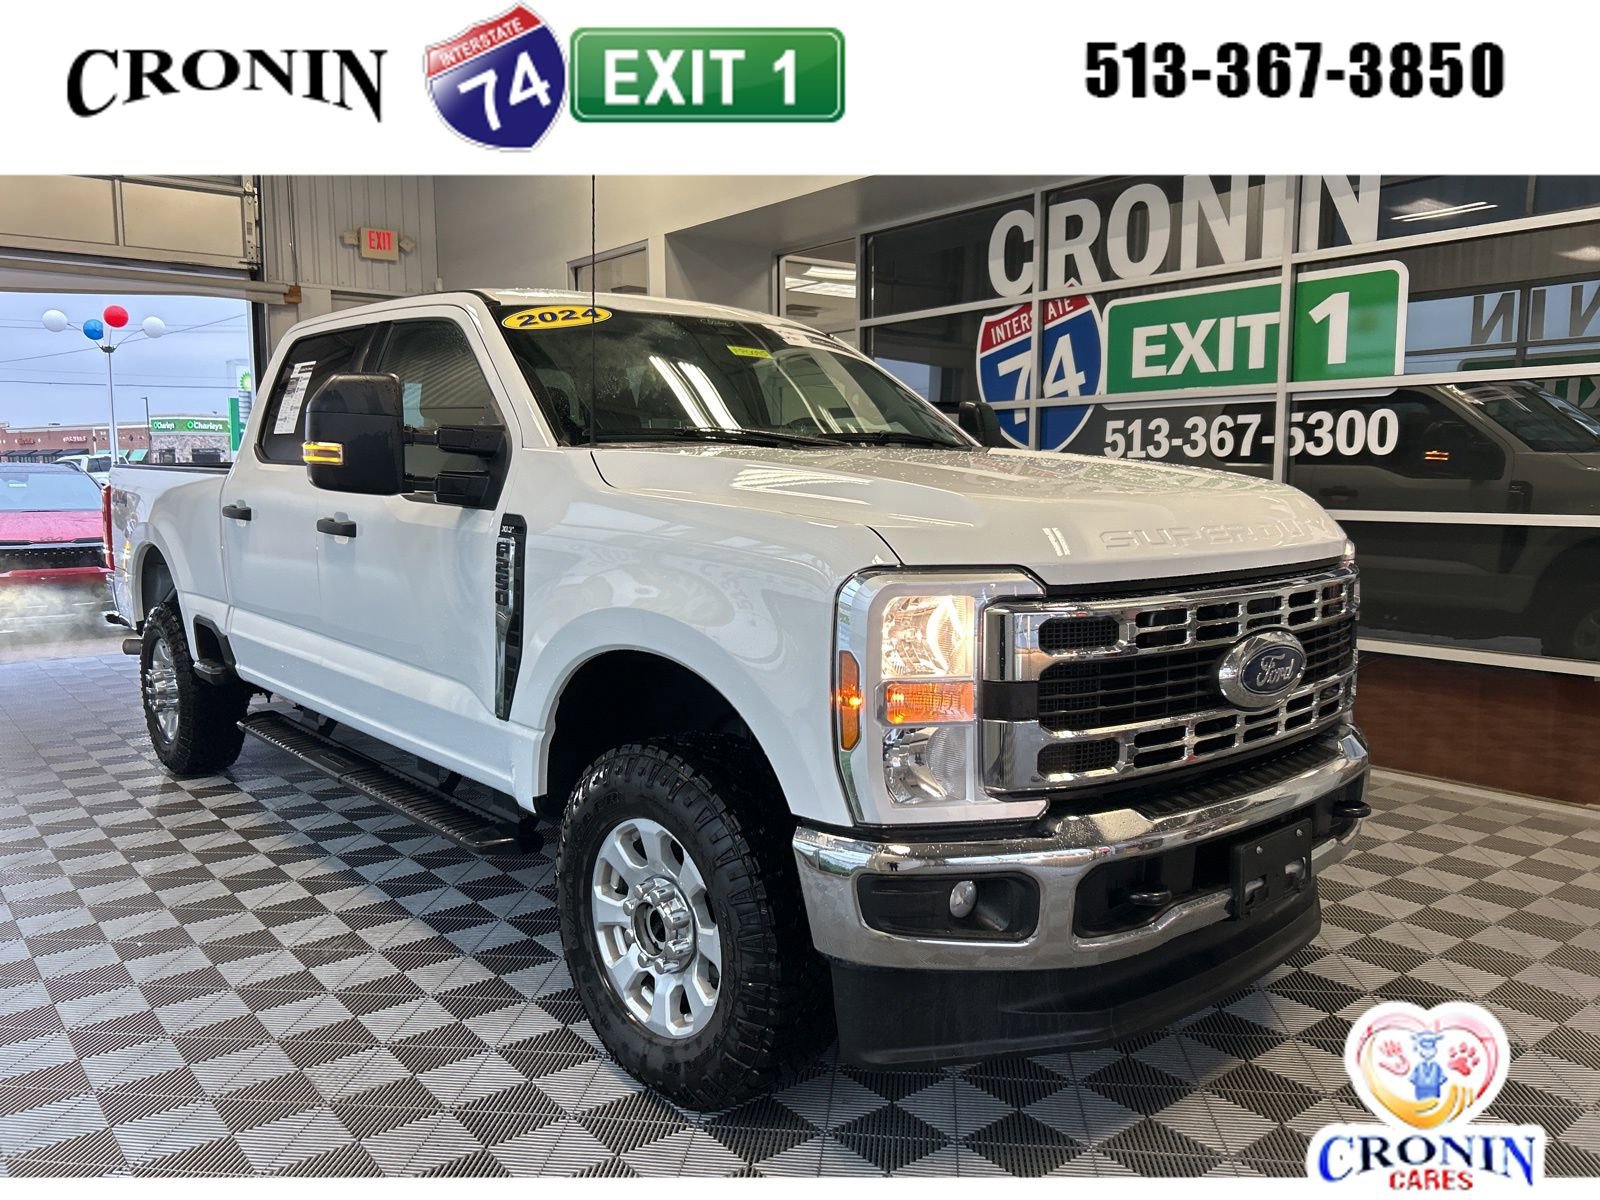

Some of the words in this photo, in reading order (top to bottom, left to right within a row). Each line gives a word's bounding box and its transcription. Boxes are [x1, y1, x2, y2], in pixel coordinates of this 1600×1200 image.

[367, 230, 392, 251] EXIT
[988, 175, 1381, 297] CRONIN
[516, 308, 601, 327] 2024
[991, 298, 1074, 345] INTERATE
[1131, 311, 1281, 379] EXIT
[1308, 291, 1351, 365] 1
[997, 333, 1086, 425] 74
[501, 525, 515, 533] XLT
[1256, 653, 1295, 687] Ford
